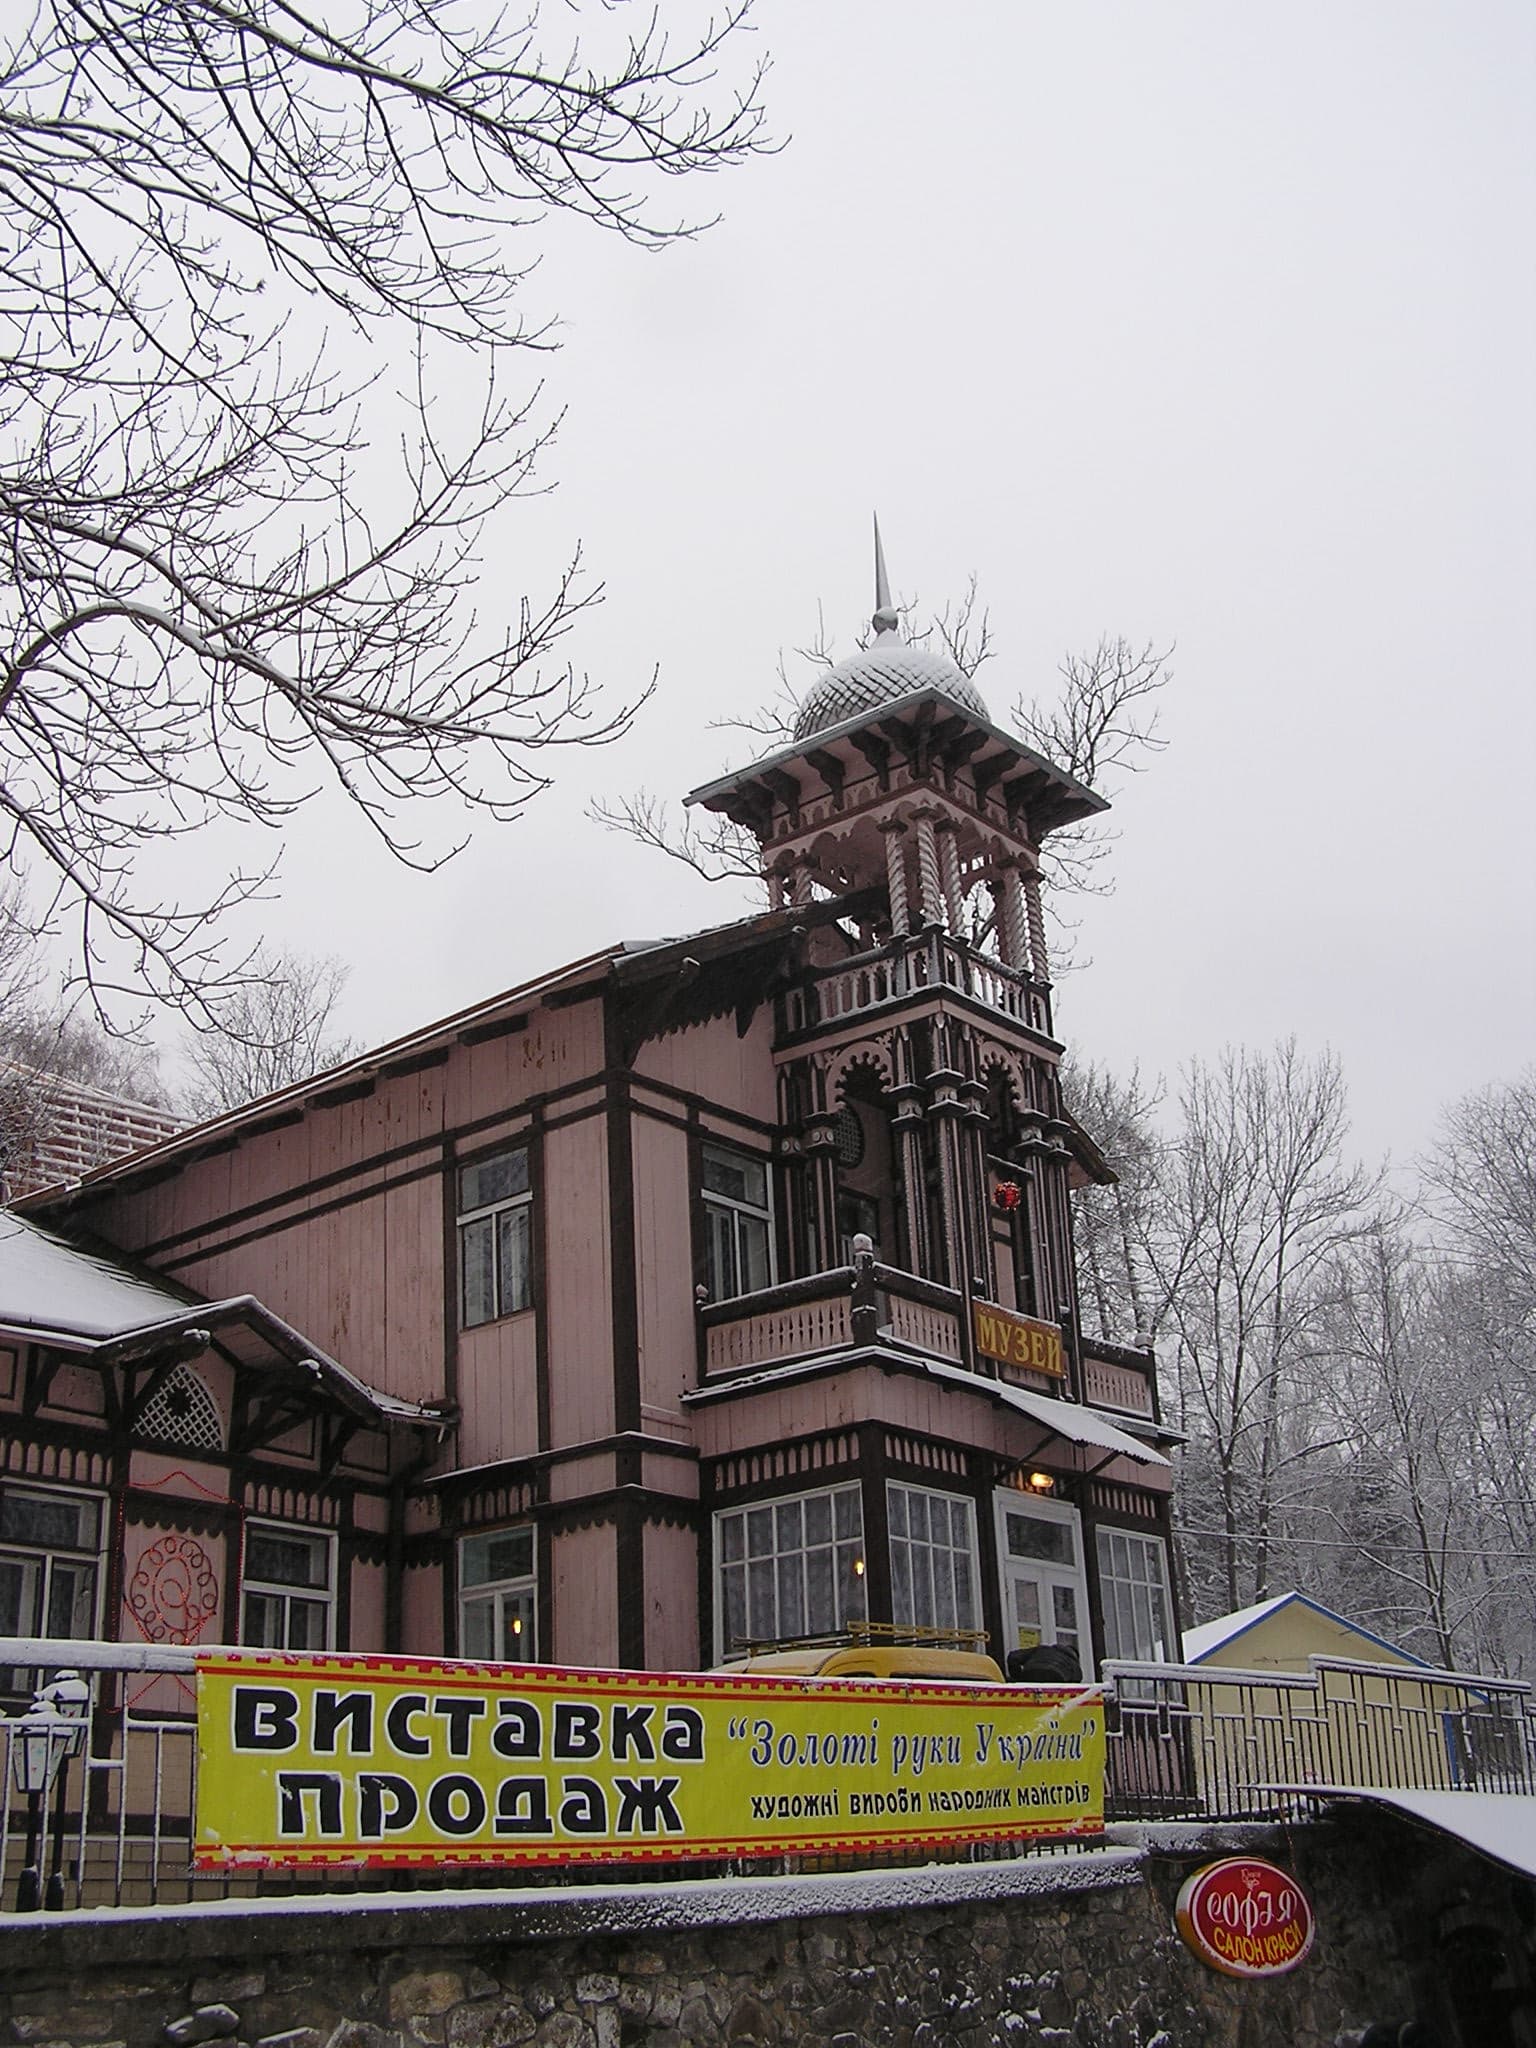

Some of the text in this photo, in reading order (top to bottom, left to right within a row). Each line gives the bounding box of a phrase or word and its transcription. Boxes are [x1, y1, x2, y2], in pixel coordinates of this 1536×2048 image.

[979, 1314, 1062, 1372] МУЗЕЙ
[892, 1730, 962, 1774] руки
[752, 1780, 1090, 1819] художні вироби народних майстрів
[1214, 1919, 1303, 1962] САЛОН КРАСИ
